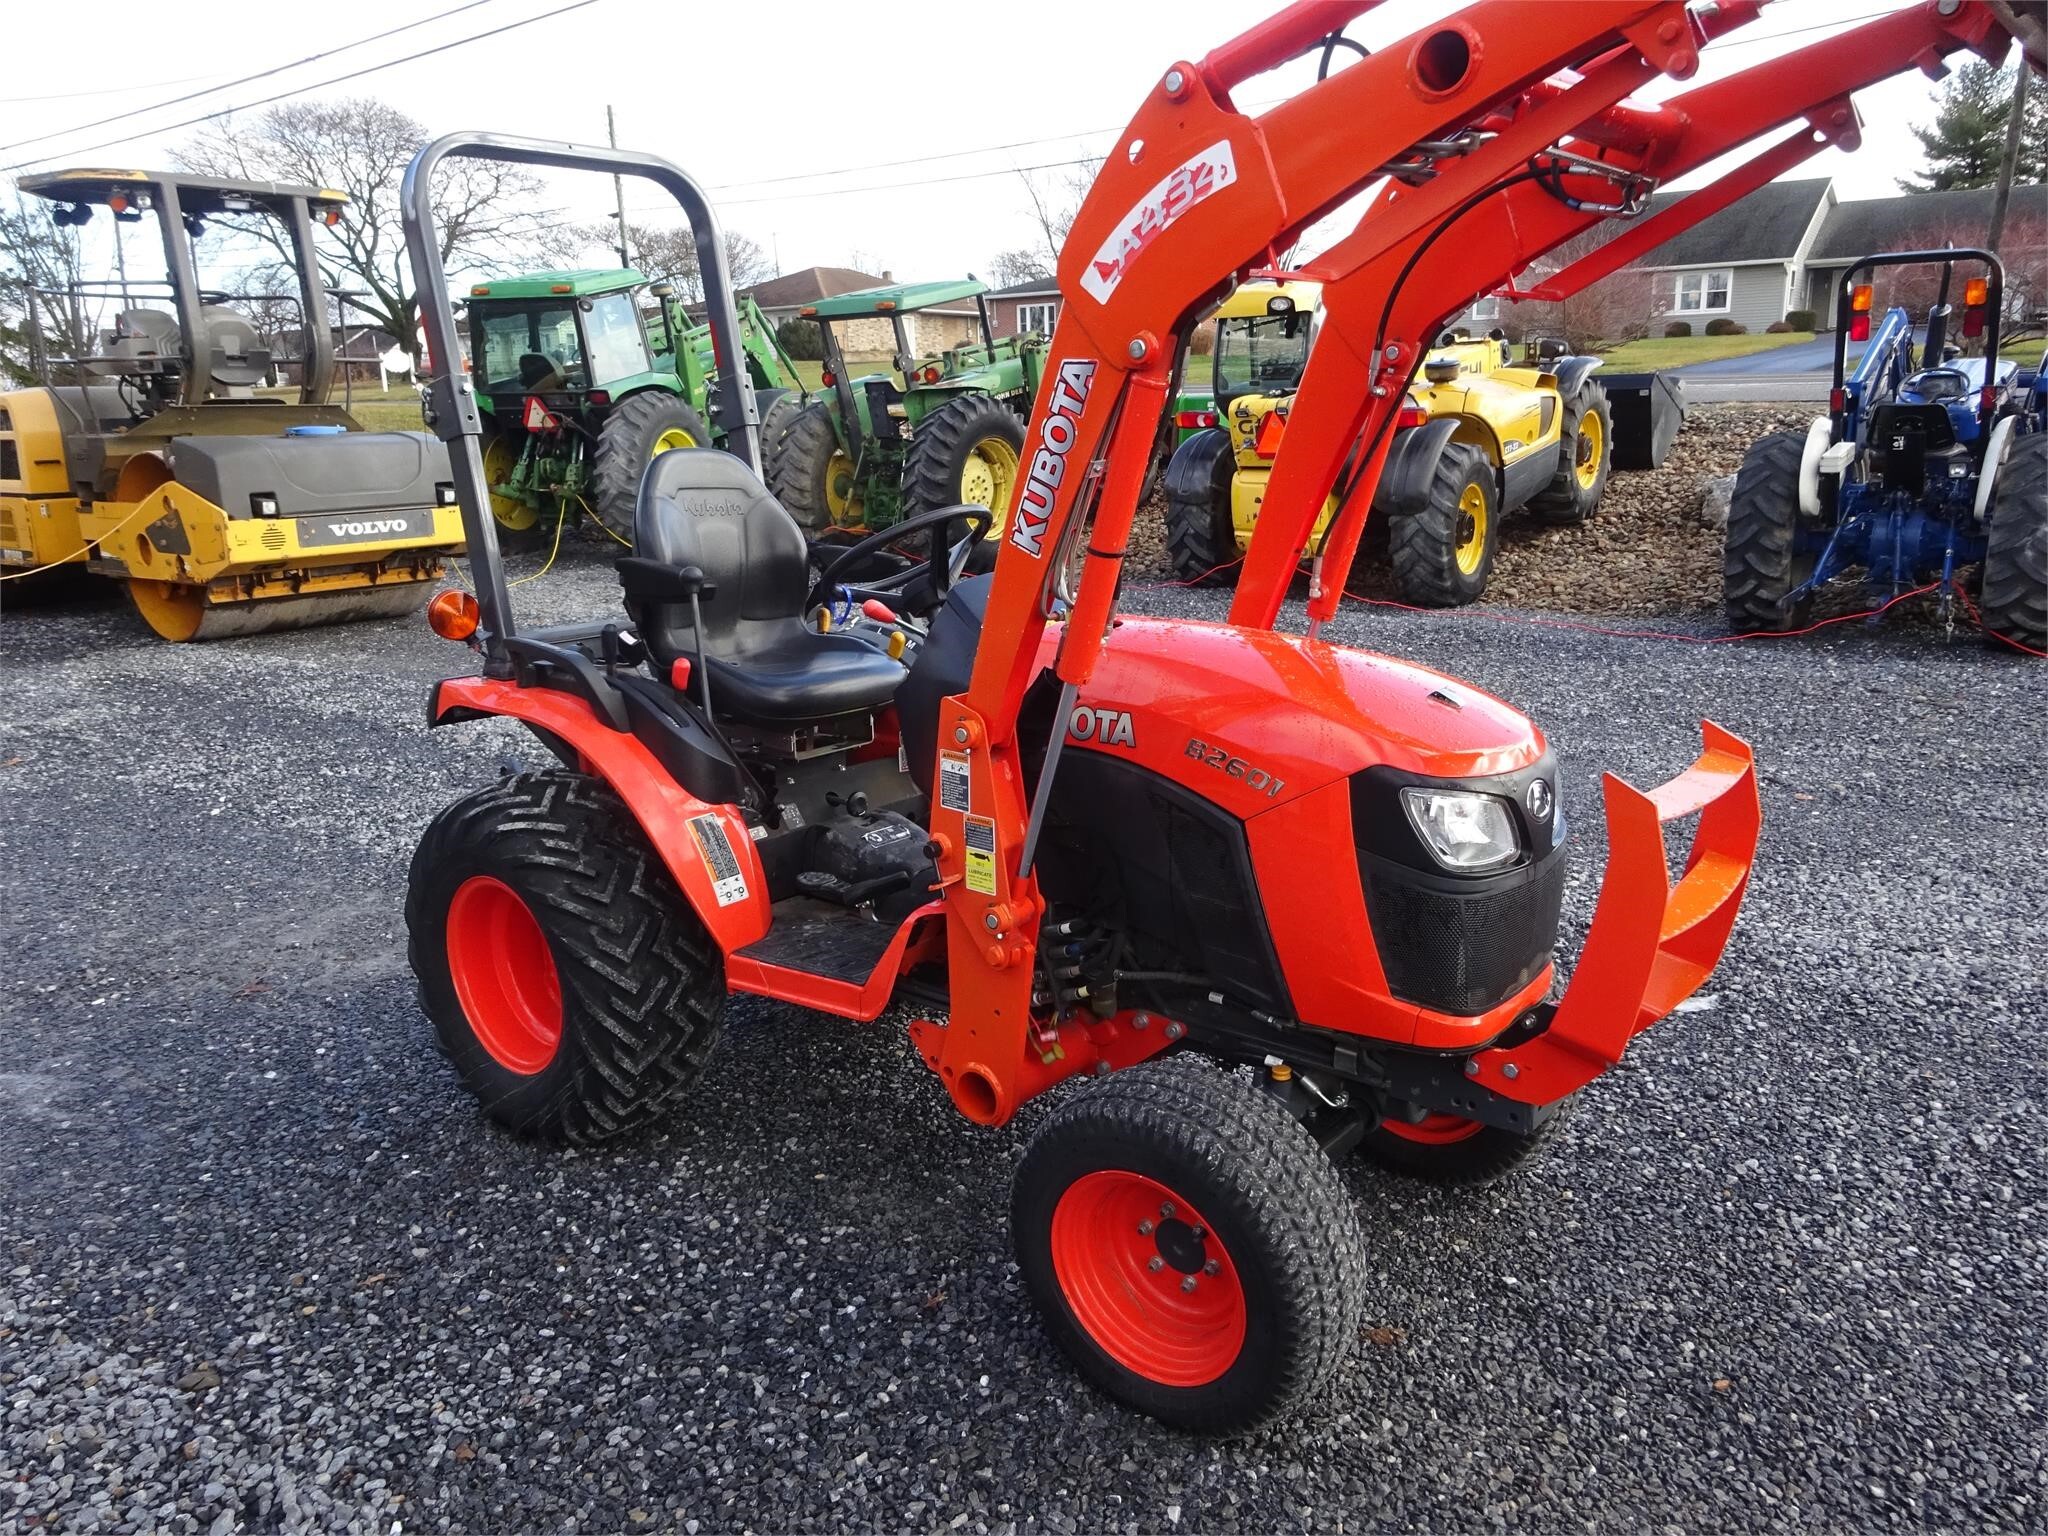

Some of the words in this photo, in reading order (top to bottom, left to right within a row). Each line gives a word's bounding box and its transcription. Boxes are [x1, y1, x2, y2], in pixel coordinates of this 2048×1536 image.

[1010, 359, 1098, 558] KUBOTA
[328, 518, 408, 537] VOLVO
[905, 639, 917, 650] M
[1069, 705, 1137, 748] OTA
[1184, 737, 1286, 798] B2601
